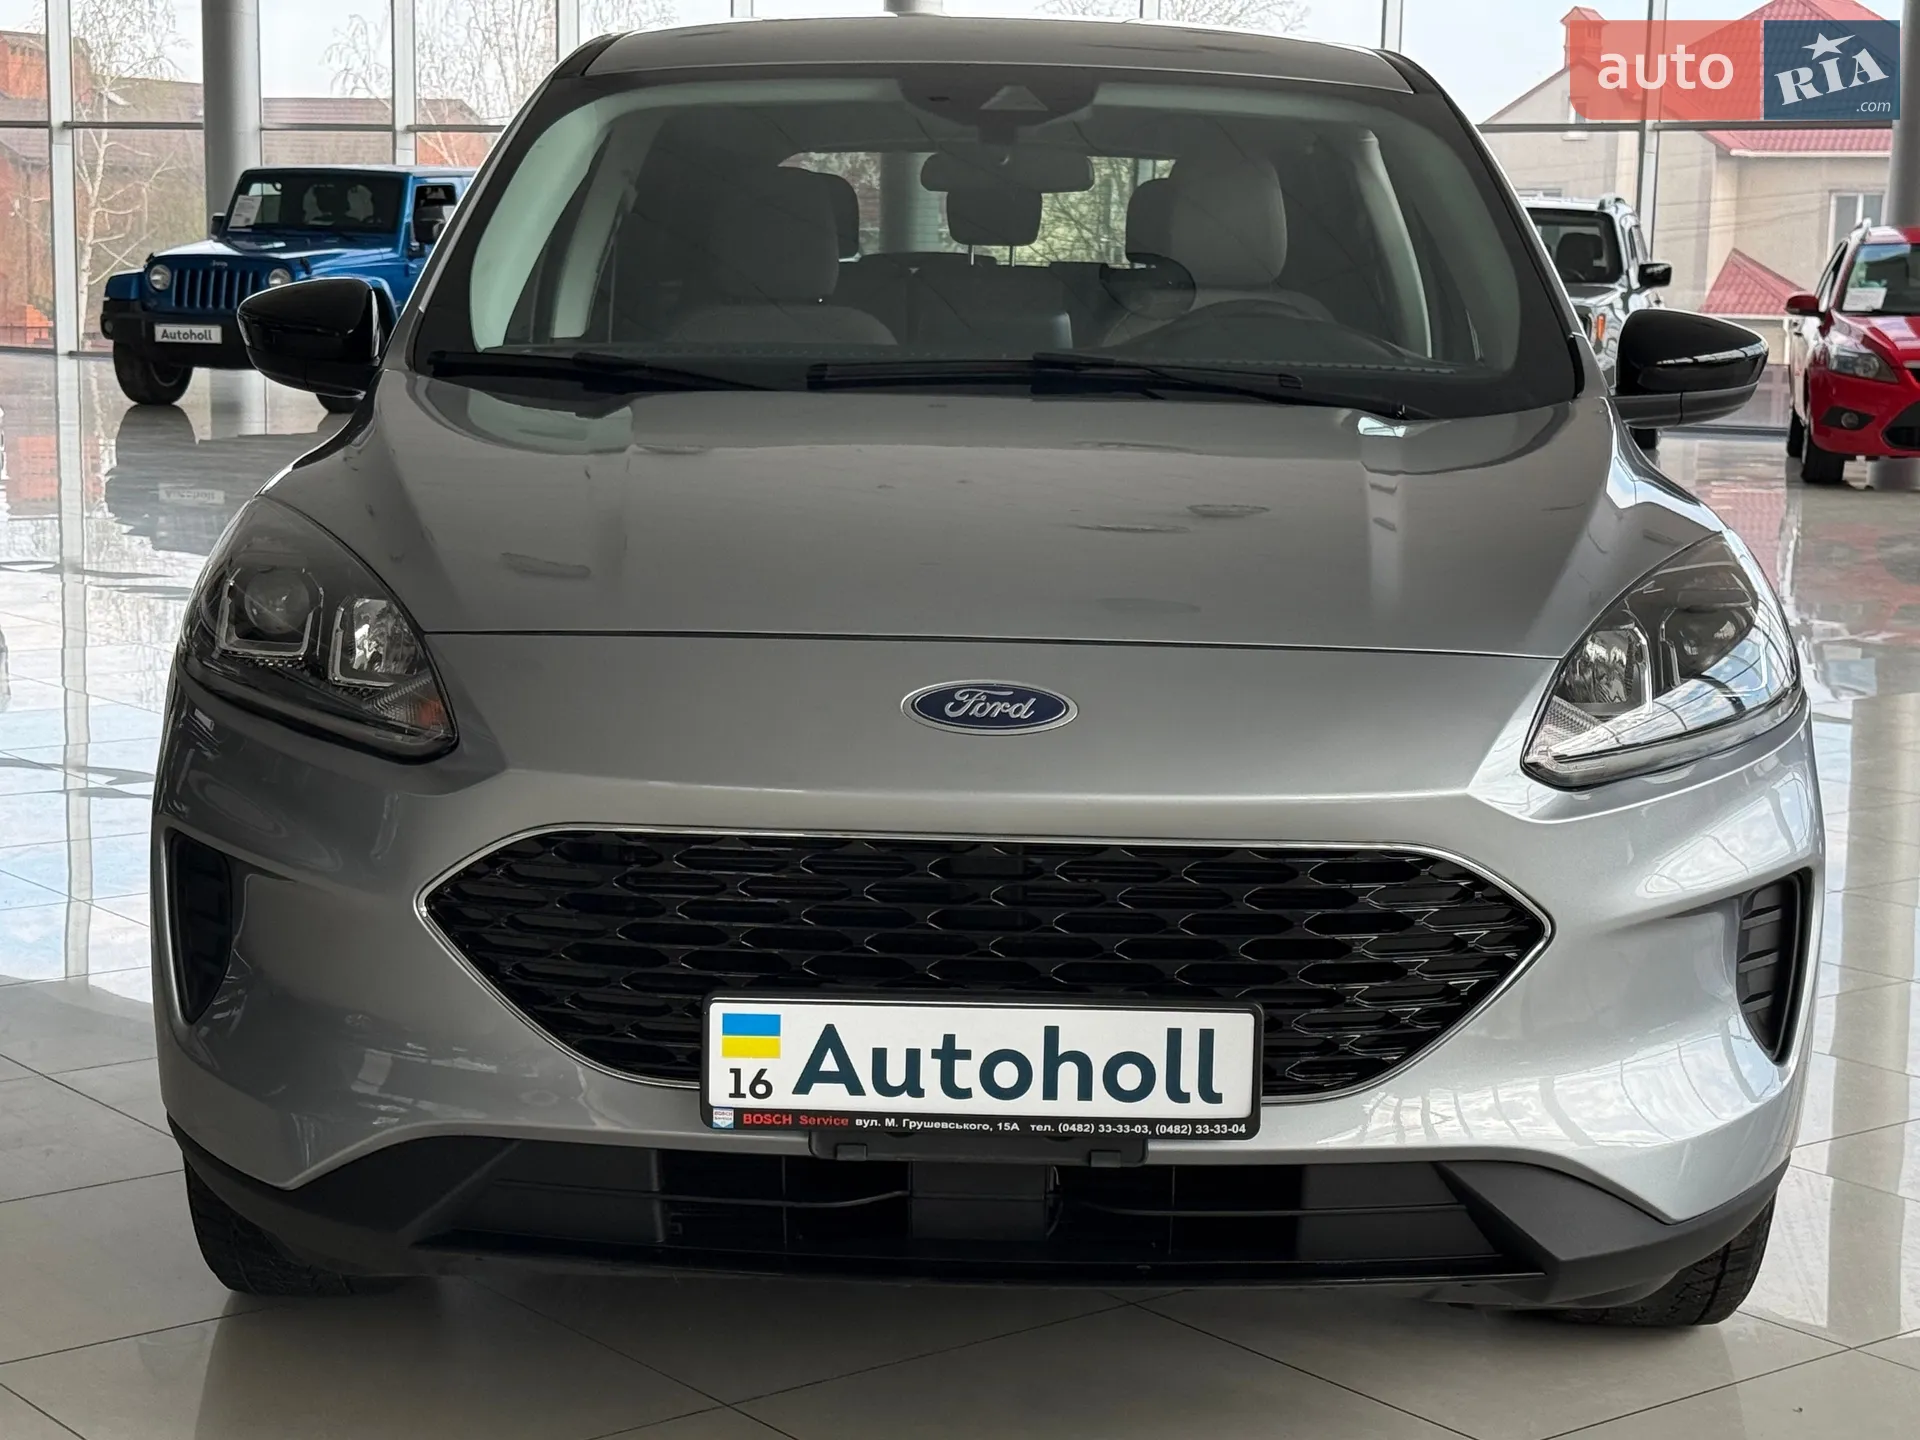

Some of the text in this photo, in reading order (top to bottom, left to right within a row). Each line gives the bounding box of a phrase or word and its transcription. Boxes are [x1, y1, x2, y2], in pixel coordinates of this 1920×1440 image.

[161, 329, 213, 341] Autoholl
[944, 688, 1037, 719] Ford
[728, 1023, 1224, 1105] 16 Autoholl
[743, 1113, 849, 1127] BOSCH Service
[855, 1118, 881, 1128] вул.
[884, 1118, 898, 1127] М.
[902, 1118, 993, 1132] Грушевського,
[1030, 1123, 1054, 1132] тел.
[1058, 1123, 1094, 1134] (0482)
[1098, 1123, 1152, 1135] 33-33-03,
[1155, 1124, 1192, 1136] (0482)
[1195, 1123, 1246, 1135] 33-33-04
